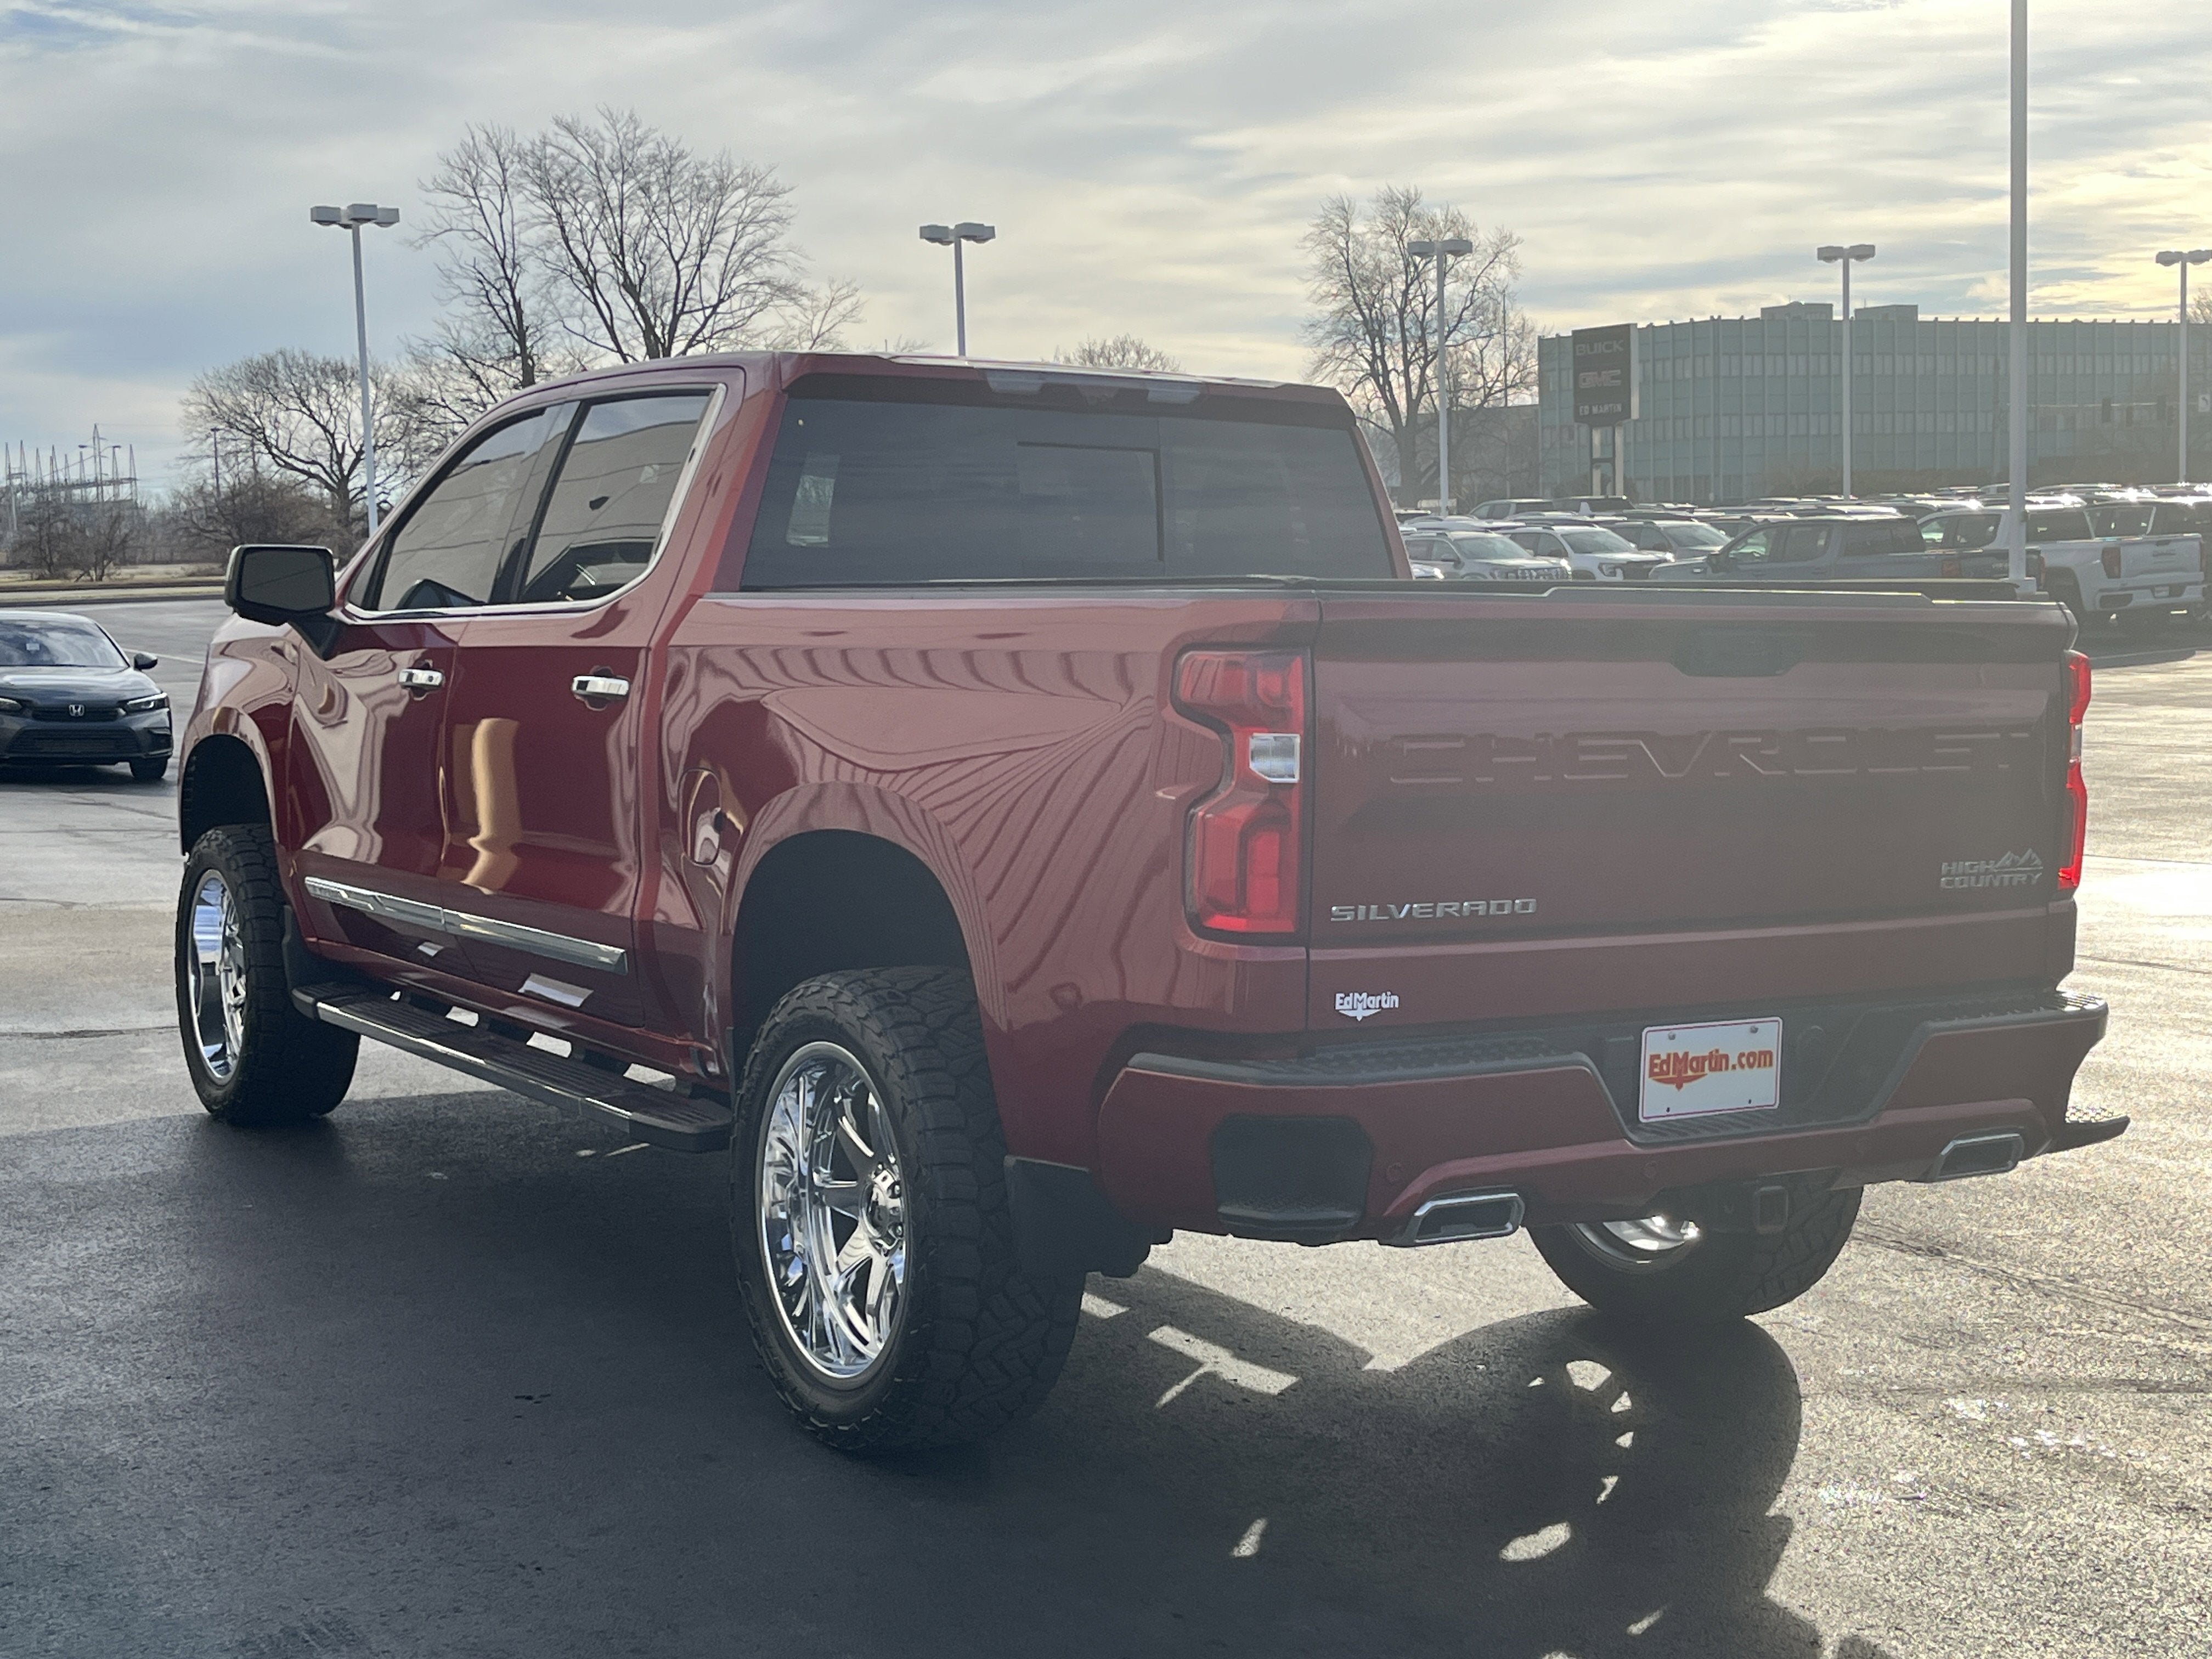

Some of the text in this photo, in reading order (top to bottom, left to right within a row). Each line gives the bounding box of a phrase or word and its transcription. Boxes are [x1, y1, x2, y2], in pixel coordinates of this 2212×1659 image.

[1576, 339, 1623, 356] BUICK
[1578, 369, 1621, 388] GMC
[1579, 403, 1622, 416] ED MARTIN
[1942, 860, 1995, 876] HIGH
[1940, 872, 2042, 889] COUNTRY
[1330, 898, 1537, 922] SILVERADO
